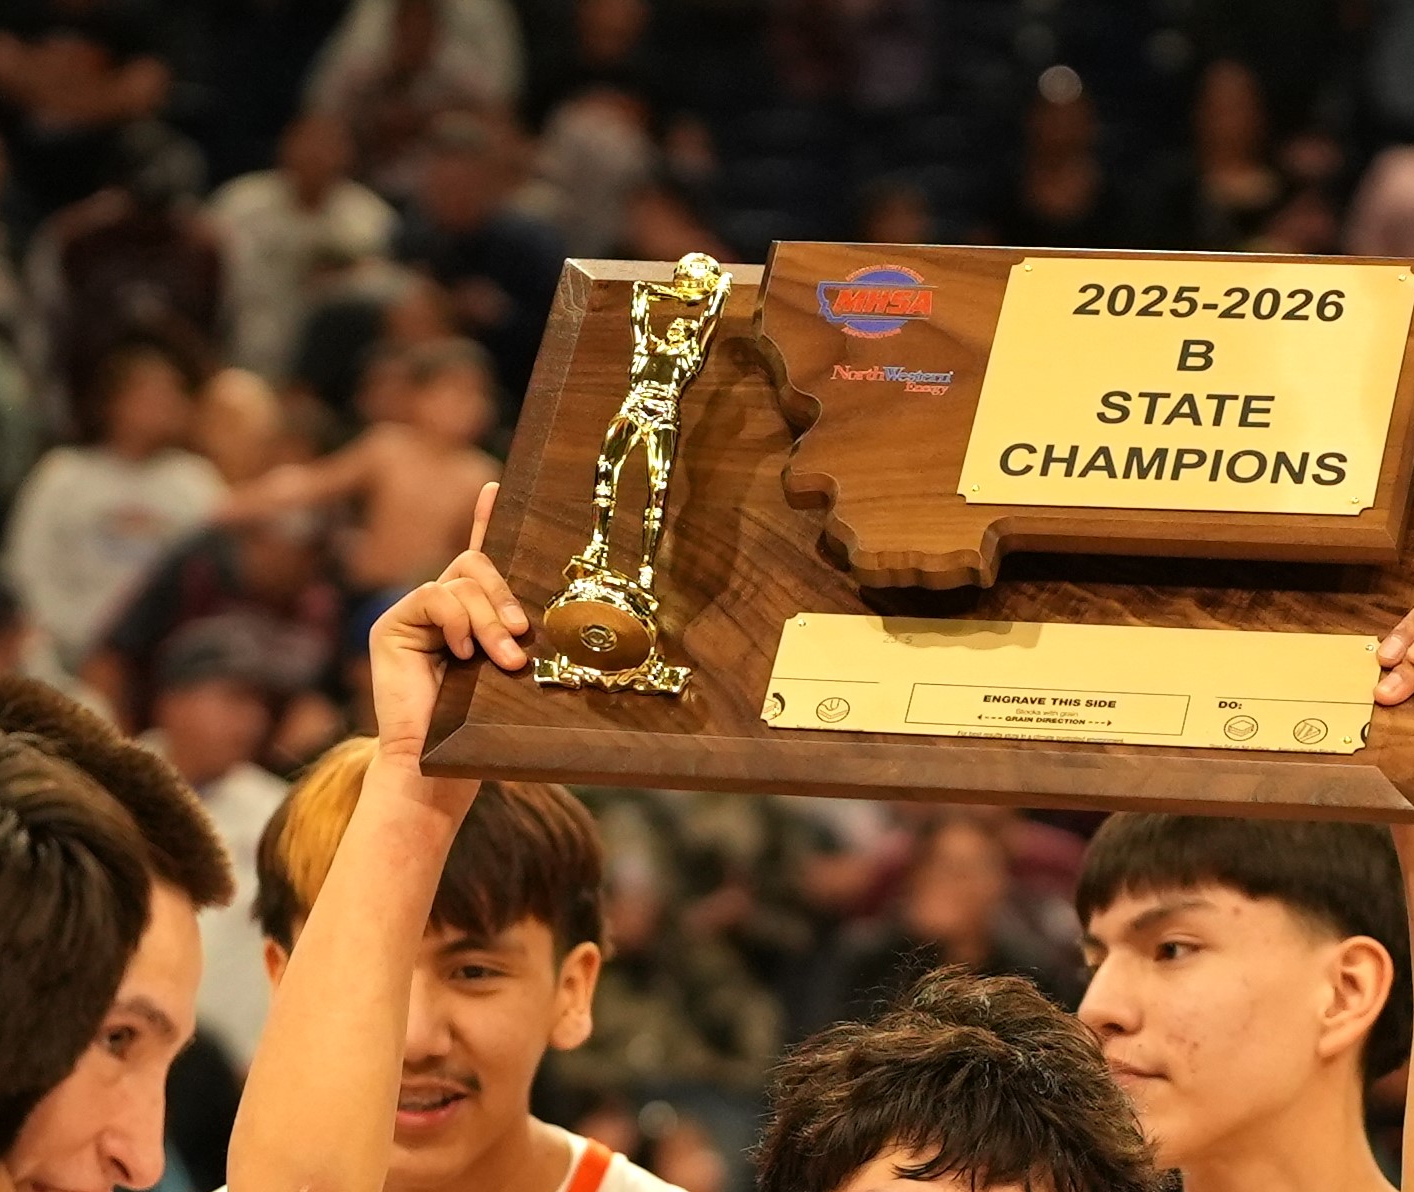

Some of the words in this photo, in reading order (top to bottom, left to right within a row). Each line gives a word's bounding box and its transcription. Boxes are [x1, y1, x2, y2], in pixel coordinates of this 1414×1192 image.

[832, 289, 933, 315] MHSA
[1073, 283, 1346, 322] 2025-2026
[1176, 339, 1215, 372] B
[830, 365, 952, 383] NorthWestern
[904, 382, 949, 396] Energy
[1096, 390, 1275, 428] STATE
[999, 443, 1348, 486] CHAMPIONS
[983, 694, 1046, 705] ENGRAVE
[1051, 697, 1081, 707] THIS
[1085, 699, 1117, 708] SIDE
[1218, 701, 1243, 710] DO:
[1005, 715, 1033, 723] GRAIN
[1036, 717, 1085, 725] DIRECTION
